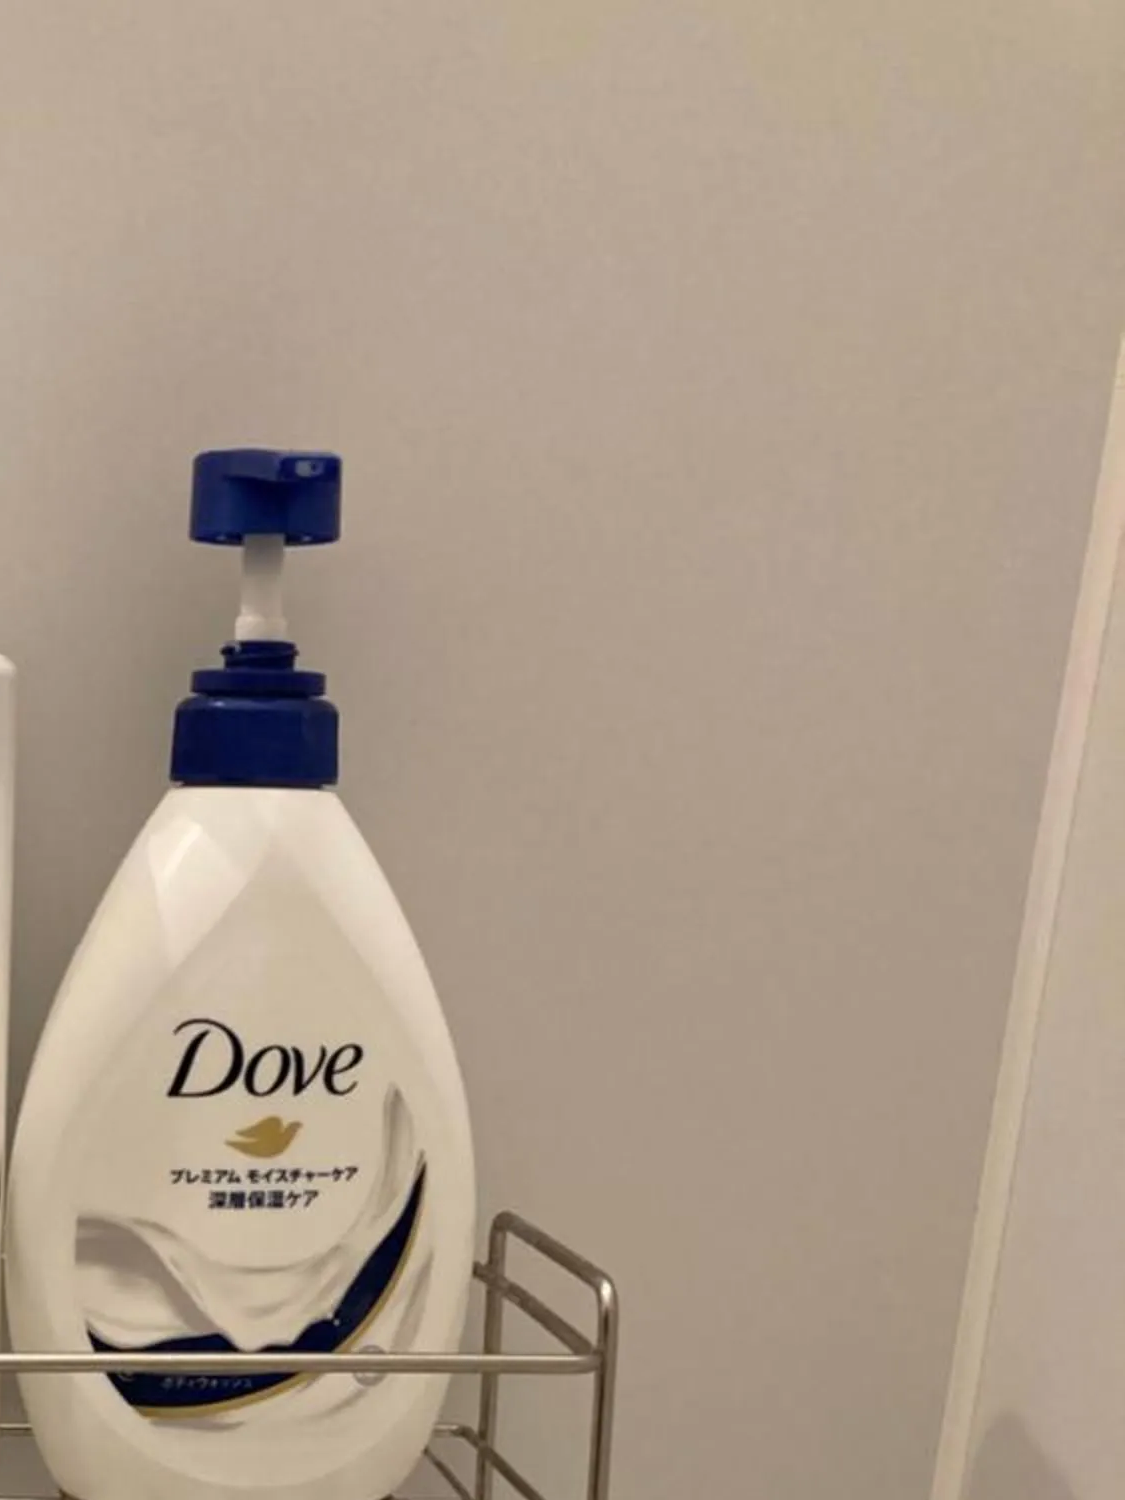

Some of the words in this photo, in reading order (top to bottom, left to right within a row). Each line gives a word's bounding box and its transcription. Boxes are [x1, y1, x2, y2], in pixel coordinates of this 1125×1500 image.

[167, 1018, 364, 1098] Dove
[170, 1168, 242, 1185] プレミアム
[247, 1166, 359, 1184] モイスチャーケア
